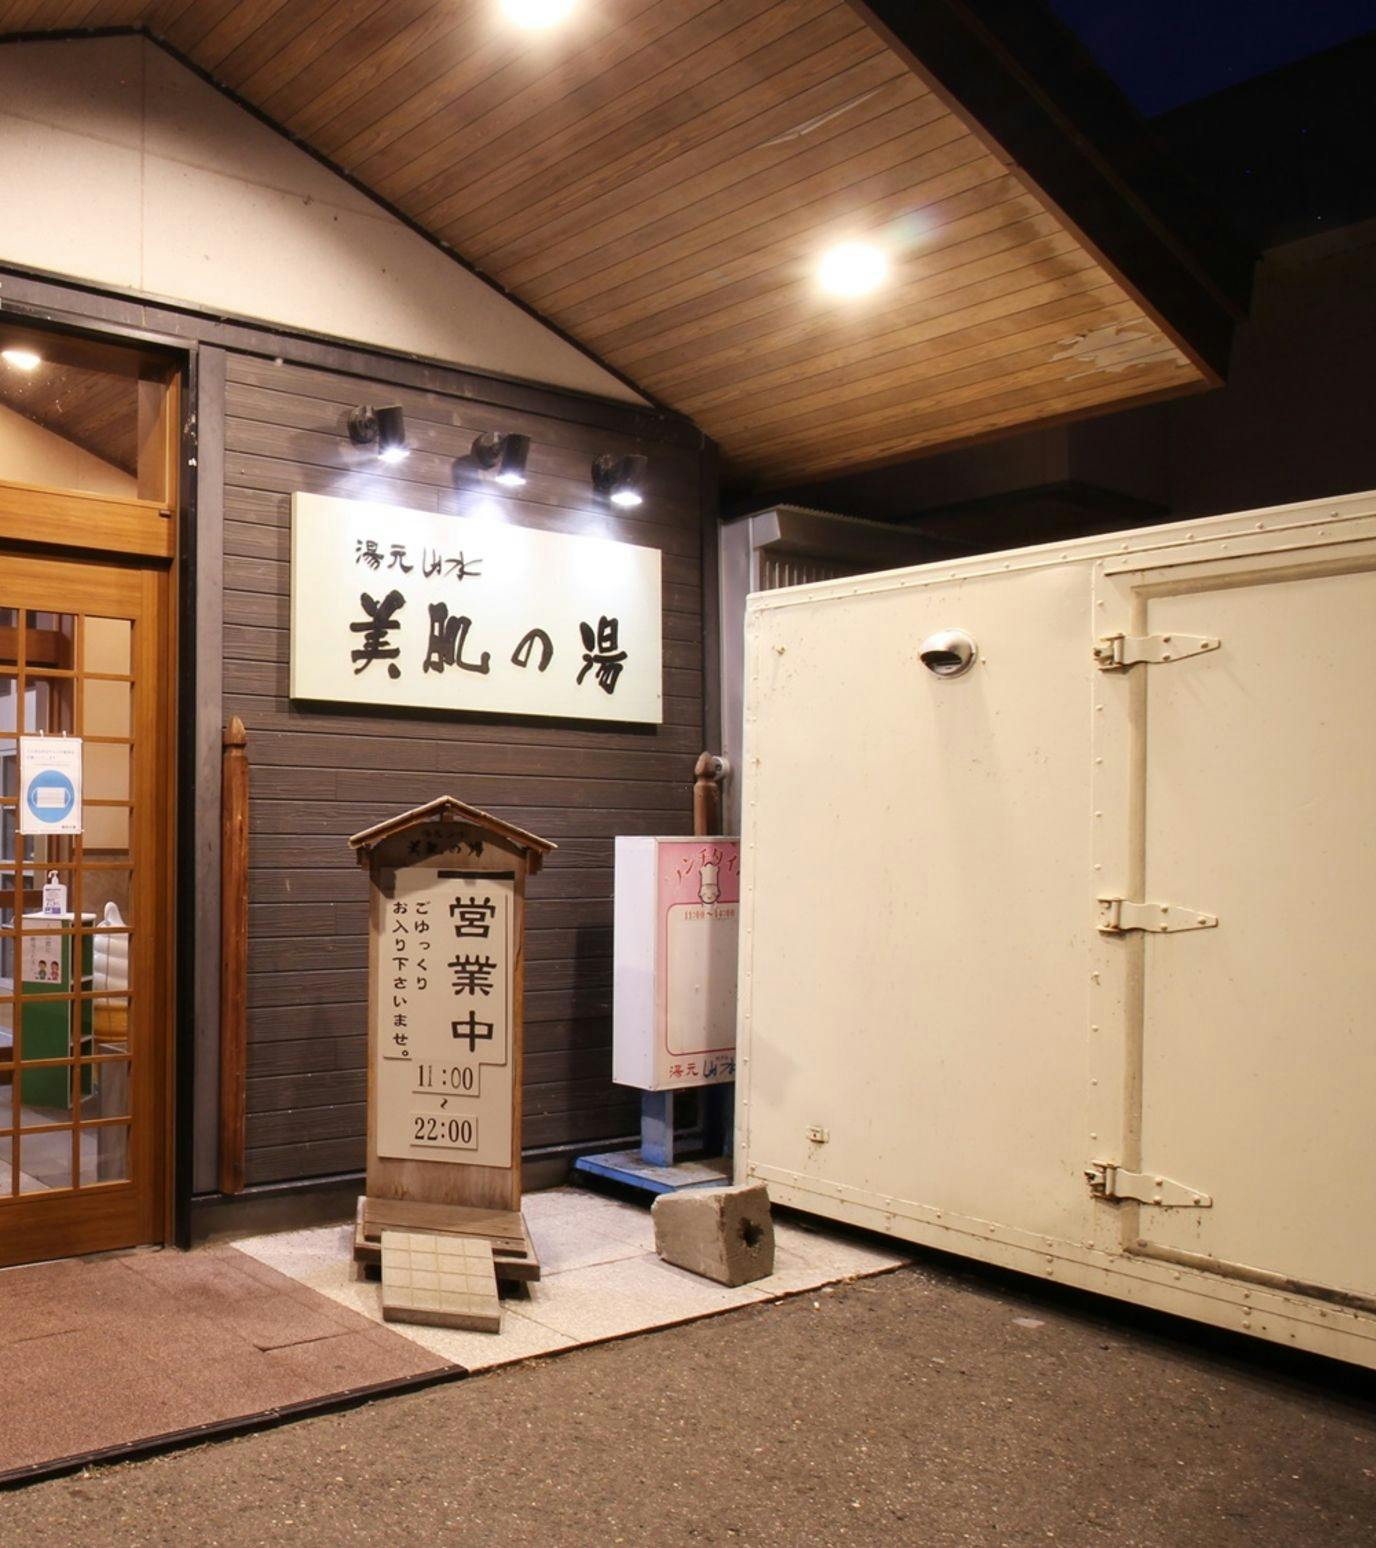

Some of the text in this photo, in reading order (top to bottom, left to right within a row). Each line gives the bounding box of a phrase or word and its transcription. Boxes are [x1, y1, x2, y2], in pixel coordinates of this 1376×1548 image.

[349, 589, 628, 695] 美肌の湯
[392, 901, 409, 1057] お入り下さいませ。
[414, 901, 431, 990] ごゆっくり
[447, 896, 498, 1053] 営業中
[418, 1064, 474, 1090] 11:00
[414, 1116, 473, 1144] 22:00
